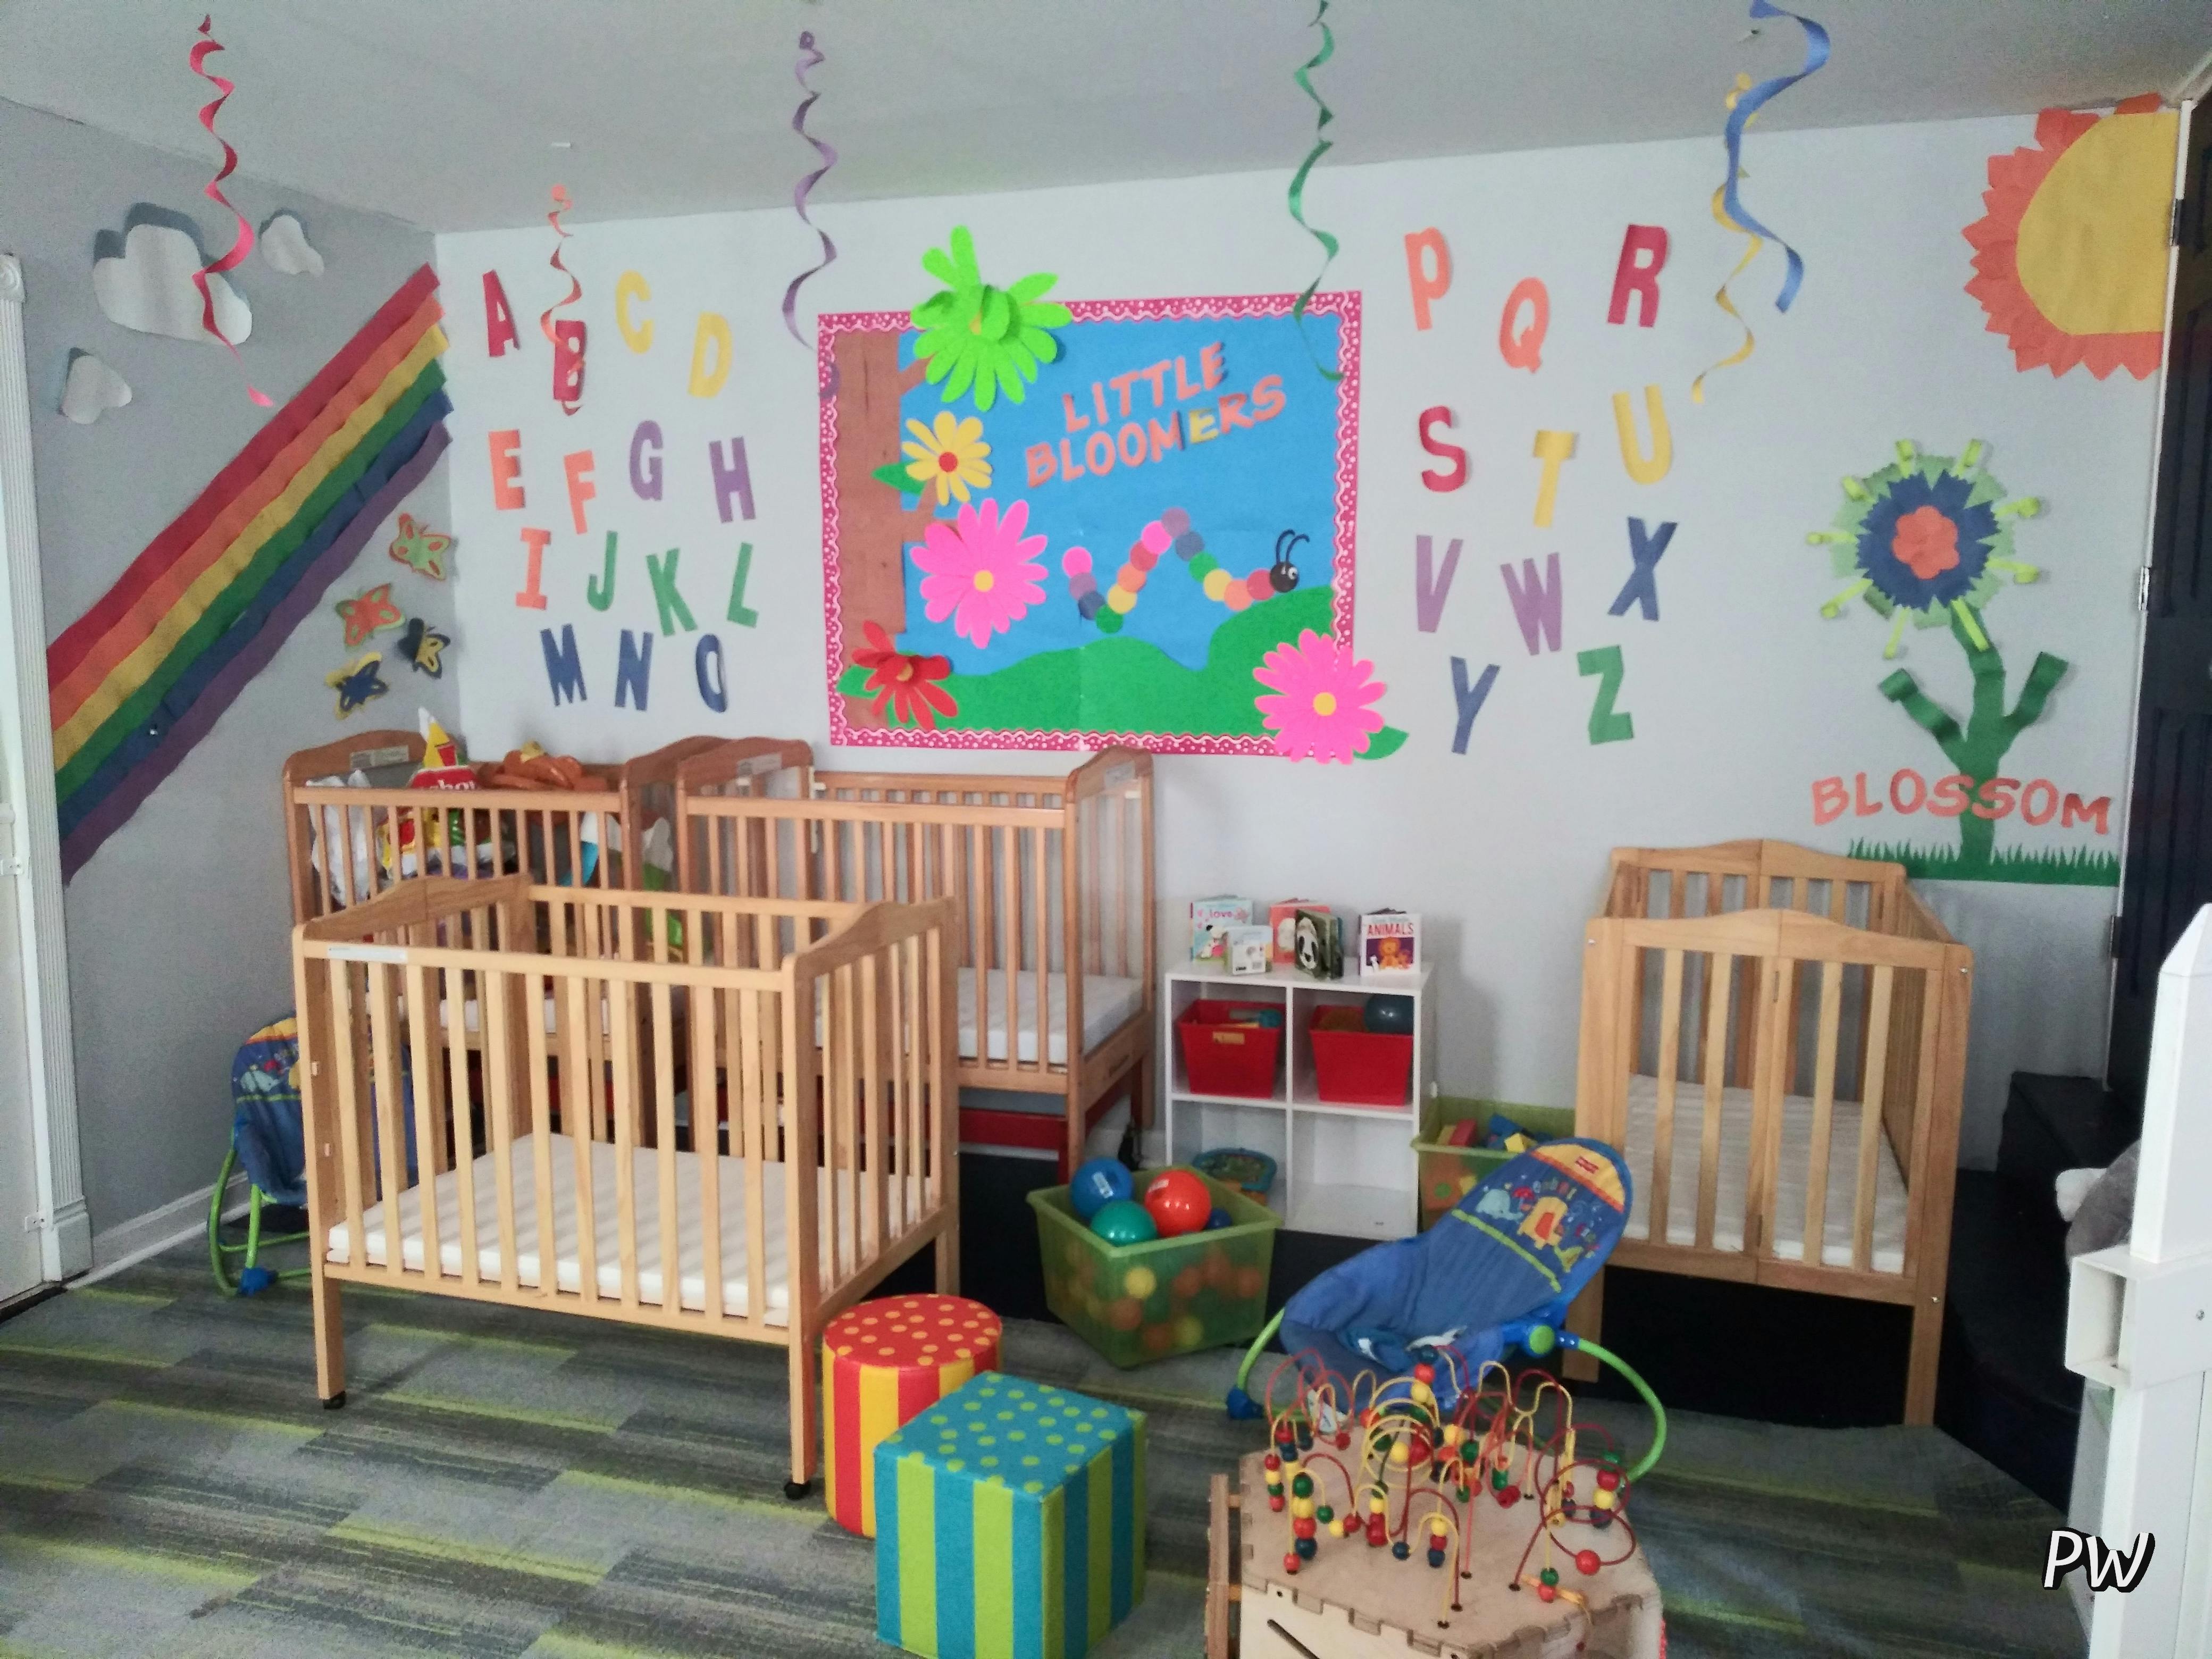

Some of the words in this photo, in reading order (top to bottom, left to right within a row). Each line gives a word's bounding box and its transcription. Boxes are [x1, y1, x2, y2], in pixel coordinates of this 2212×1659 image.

[483, 270, 519, 357] A
[553, 320, 586, 401] B
[616, 271, 653, 354] C
[688, 312, 732, 398] D
[1405, 228, 1449, 330] P
[1499, 278, 1548, 372] Q
[1607, 224, 1668, 327] R
[1025, 375, 1286, 488] BLOOMERS
[1062, 341, 1225, 432] LITTLE
[489, 430, 524, 510] E
[564, 451, 597, 534] F
[629, 421, 663, 500] G
[710, 437, 755, 521] H
[1419, 406, 1467, 492] S
[1534, 430, 1574, 527] T
[1613, 385, 1671, 484] U
[516, 527, 550, 609] I
[587, 531, 617, 611] J
[646, 550, 695, 635] K
[726, 543, 757, 627] L
[1415, 537, 1460, 632] V
[1502, 552, 1562, 655] W
[1608, 517, 1677, 621] X
[541, 624, 586, 706] M
[616, 630, 651, 709] N
[696, 634, 726, 713] O
[1451, 658, 1499, 753] Y
[1578, 647, 1633, 743] Z
[1812, 768, 2111, 834] BLOSSOM
[1368, 923, 1414, 935] ANIMALS
